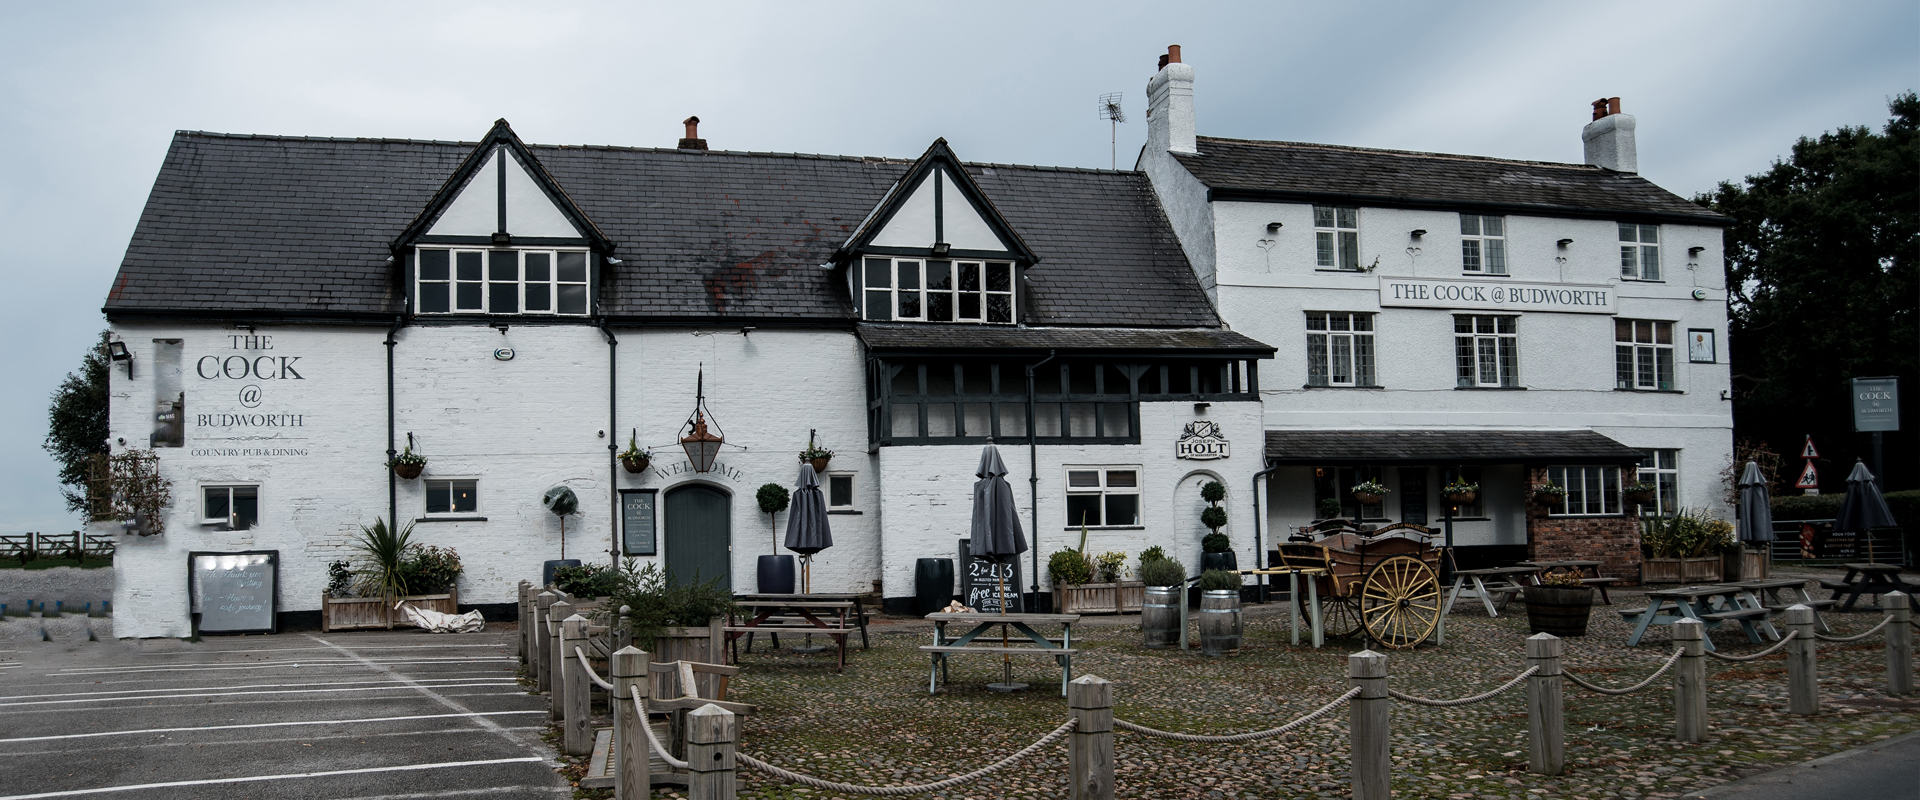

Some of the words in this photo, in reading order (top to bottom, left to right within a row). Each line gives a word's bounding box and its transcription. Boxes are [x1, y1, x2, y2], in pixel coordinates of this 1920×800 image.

[1391, 284, 1430, 300] THE
[1434, 285, 1488, 302] COCK
[1491, 287, 1506, 304] @
[1509, 288, 1608, 306] BUDWORTH
[228, 335, 274, 350] THE
[196, 356, 306, 380] COCK
[239, 384, 262, 408] @
[1860, 392, 1891, 400] COCK
[197, 414, 304, 426] BUDWORTH
[191, 448, 241, 456] COUNTRY
[1180, 444, 1226, 453] HOLT
[969, 563, 980, 576] 2
[970, 587, 990, 606] free
